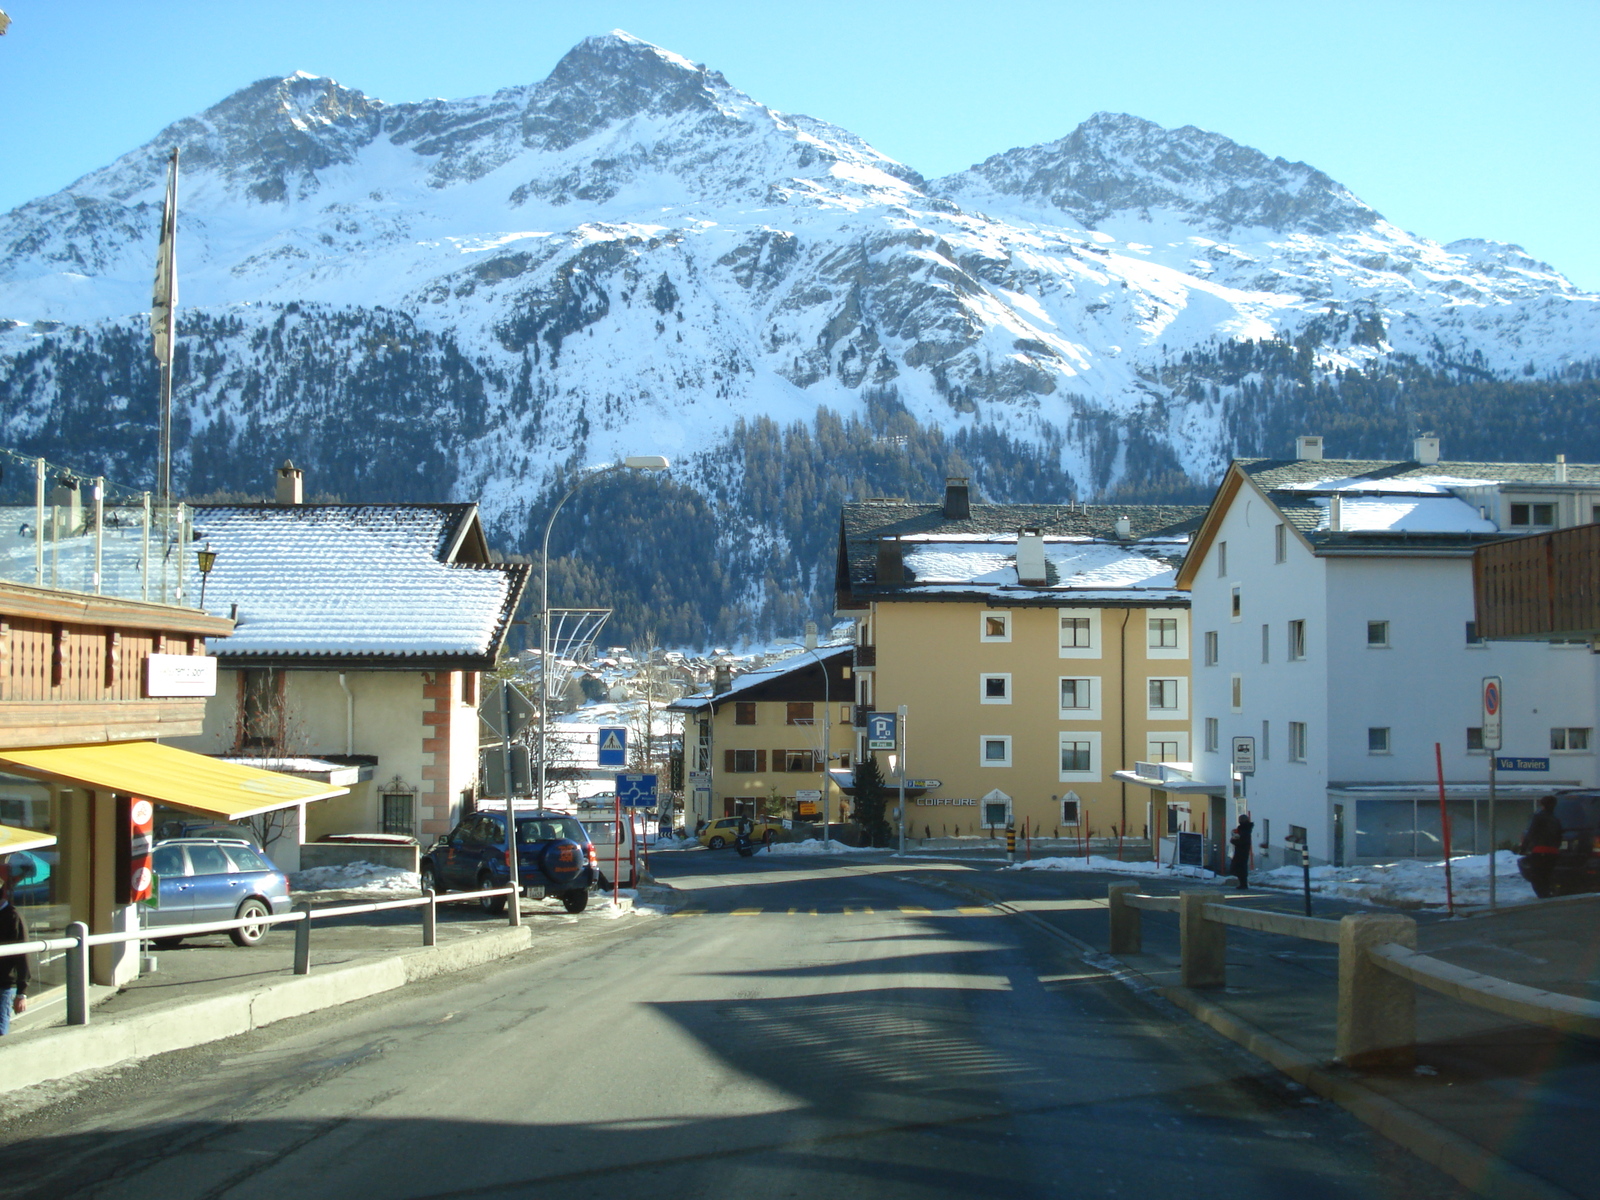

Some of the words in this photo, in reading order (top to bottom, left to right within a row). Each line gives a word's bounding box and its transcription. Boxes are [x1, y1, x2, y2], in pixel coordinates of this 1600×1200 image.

[876, 721, 887, 736] P
[1500, 759, 1514, 769] Via
[1516, 759, 1546, 770] Traviers
[916, 798, 978, 806] COIFFURE
